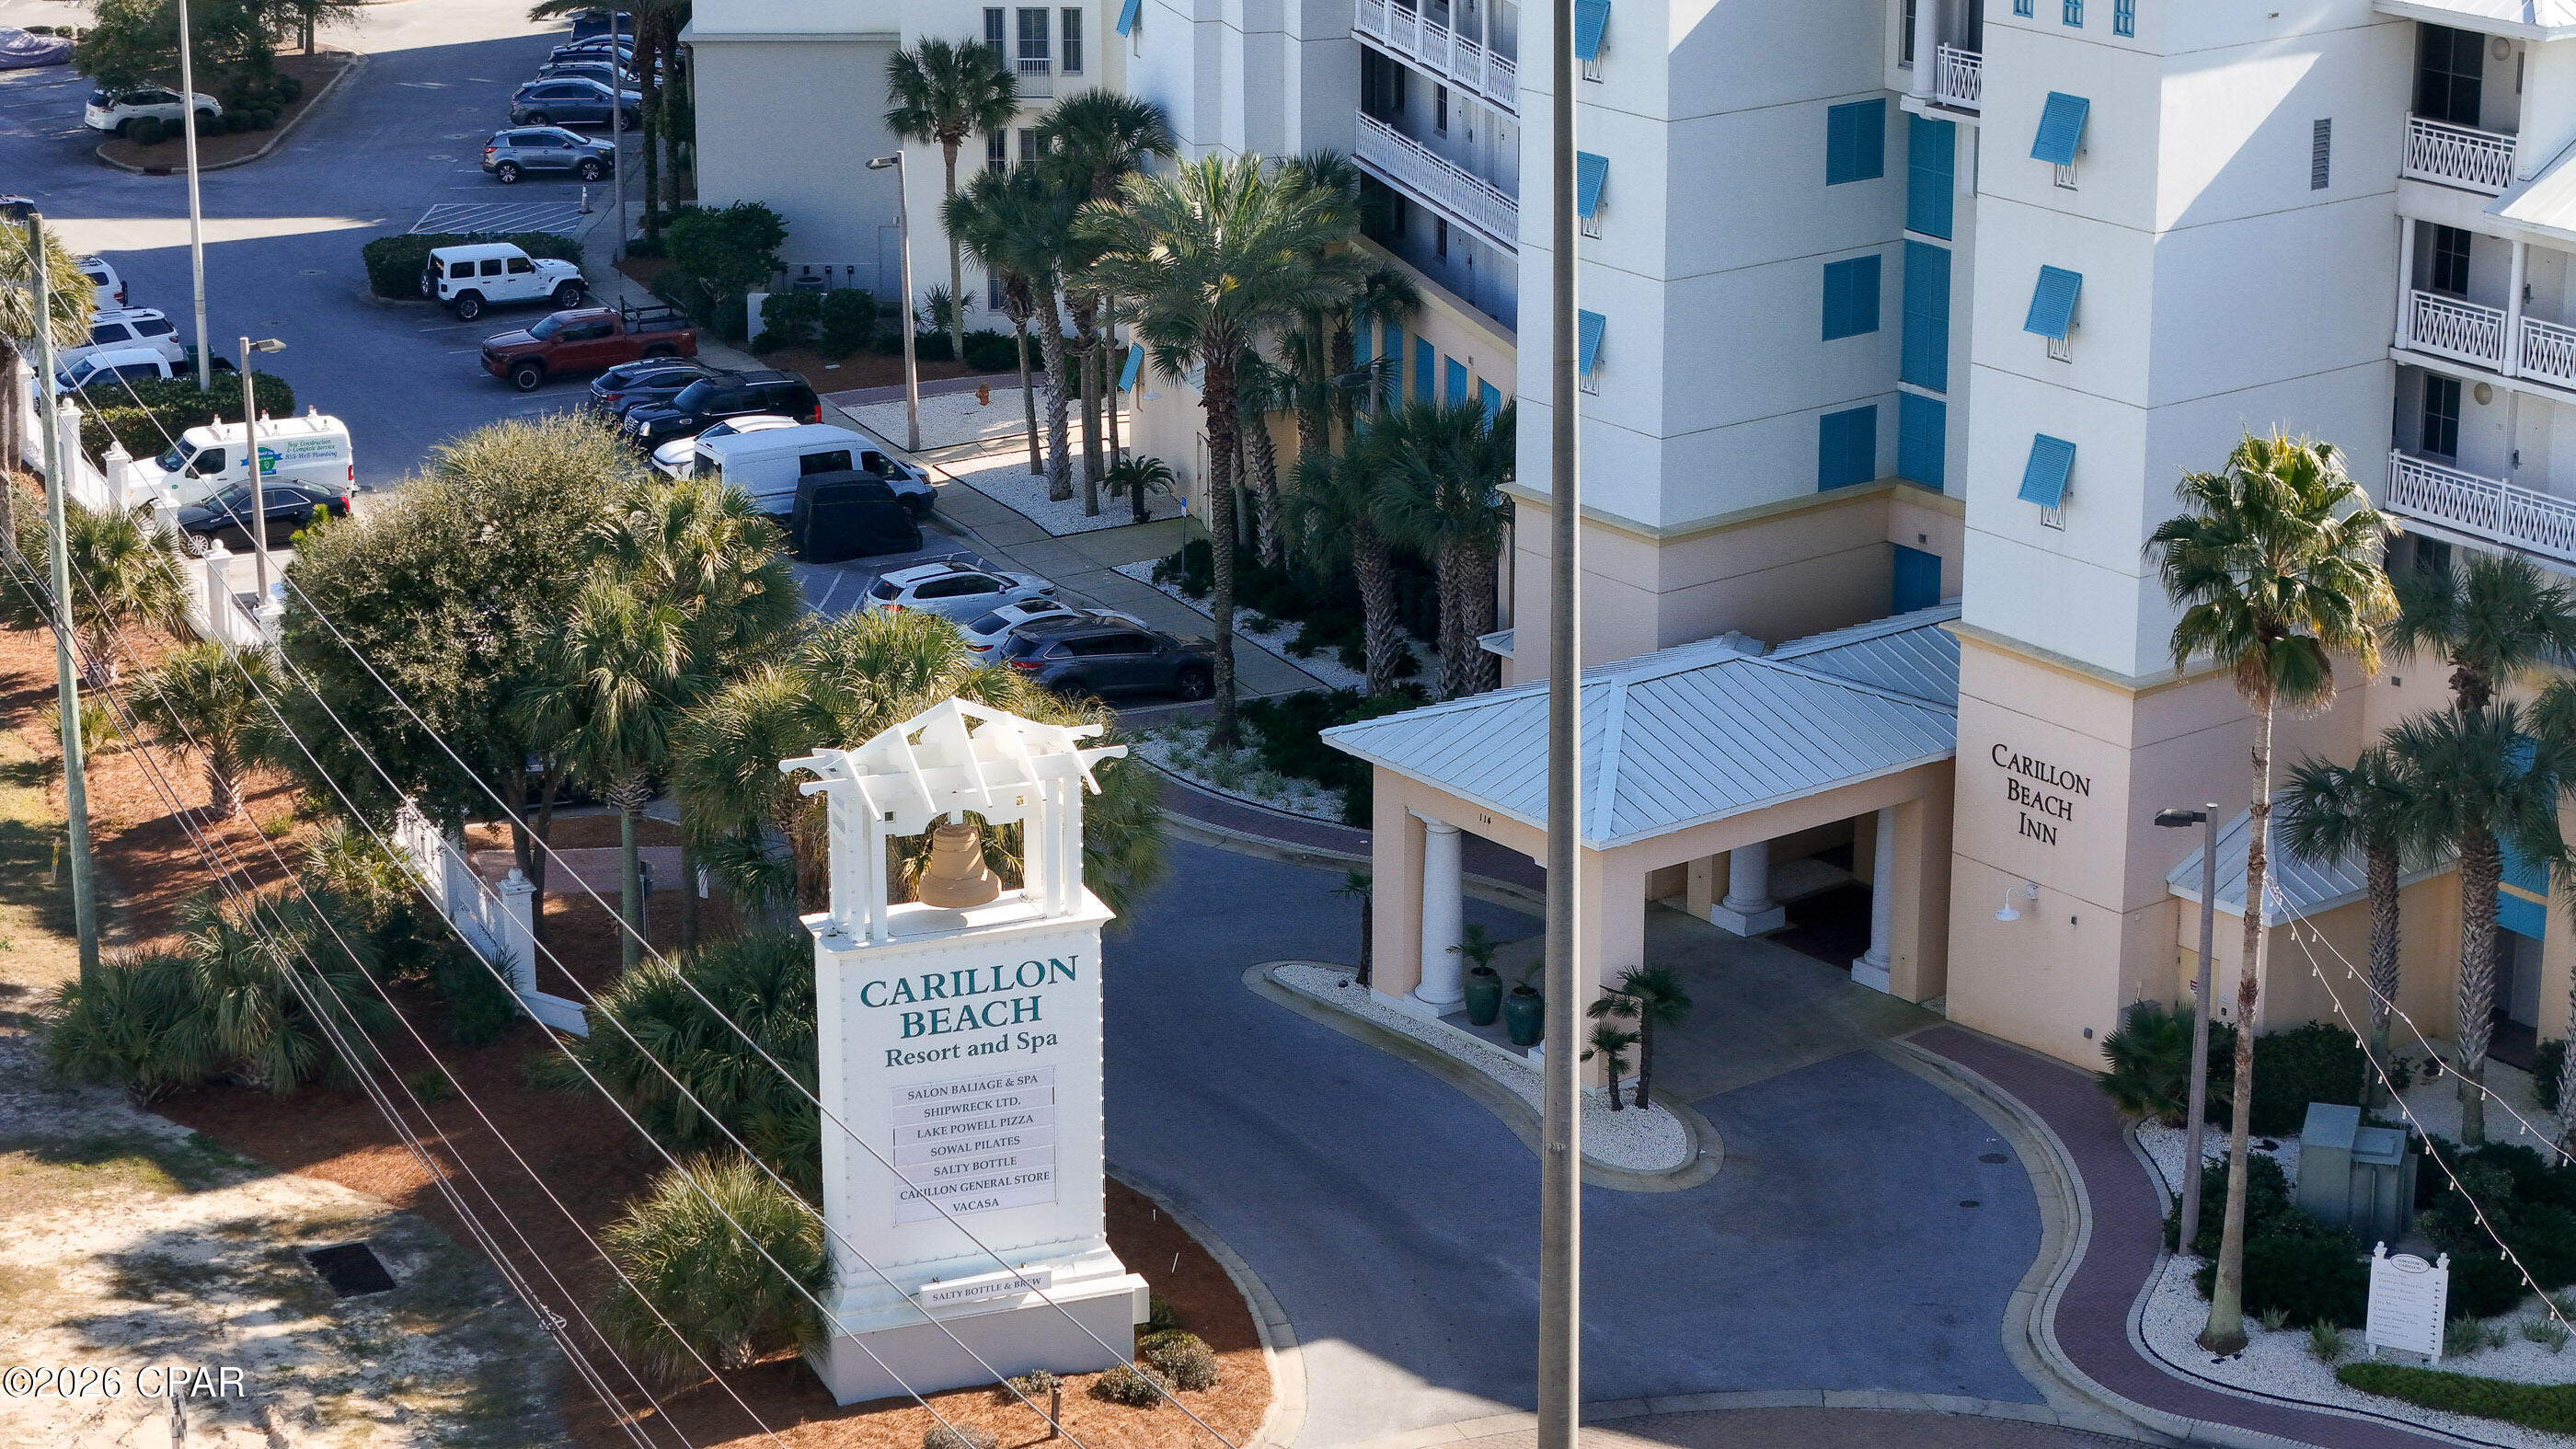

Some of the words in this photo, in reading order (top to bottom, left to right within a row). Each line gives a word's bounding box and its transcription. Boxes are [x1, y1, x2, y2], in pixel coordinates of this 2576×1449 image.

[1992, 743, 2090, 797] CARILLON
[2007, 776, 2073, 822] BEACH
[1479, 813, 1491, 824] 114
[2018, 811, 2057, 846] INN
[860, 955, 1079, 1008] CARILLON
[900, 995, 1042, 1040] BEACH
[885, 1042, 961, 1067] Resort
[968, 1034, 1009, 1055] and
[1017, 1031, 1058, 1053] Spa
[907, 1086, 949, 1100] SALON
[951, 1079, 1003, 1094] BALIAGE
[1006, 1077, 1015, 1087] &
[1017, 1075, 1038, 1086] SPA
[924, 1099, 993, 1118] SHIPWRECK
[995, 1097, 1020, 1108] LTD.
[917, 1125, 948, 1138] LAKE
[950, 1119, 996, 1134] POWELL
[1000, 1114, 1034, 1127] PIZZA
[930, 1143, 972, 1156] SOWAL
[974, 1136, 1020, 1150] PILATES
[934, 1163, 970, 1176] SALTY
[972, 1156, 1017, 1171] BOTTLE
[960, 1177, 1012, 1191] GENERAL
[1014, 1171, 1050, 1185] STORE
[952, 1198, 999, 1212] VACASA
[932, 1290, 963, 1302] SALTY
[965, 1283, 1002, 1296] BOTTLE
